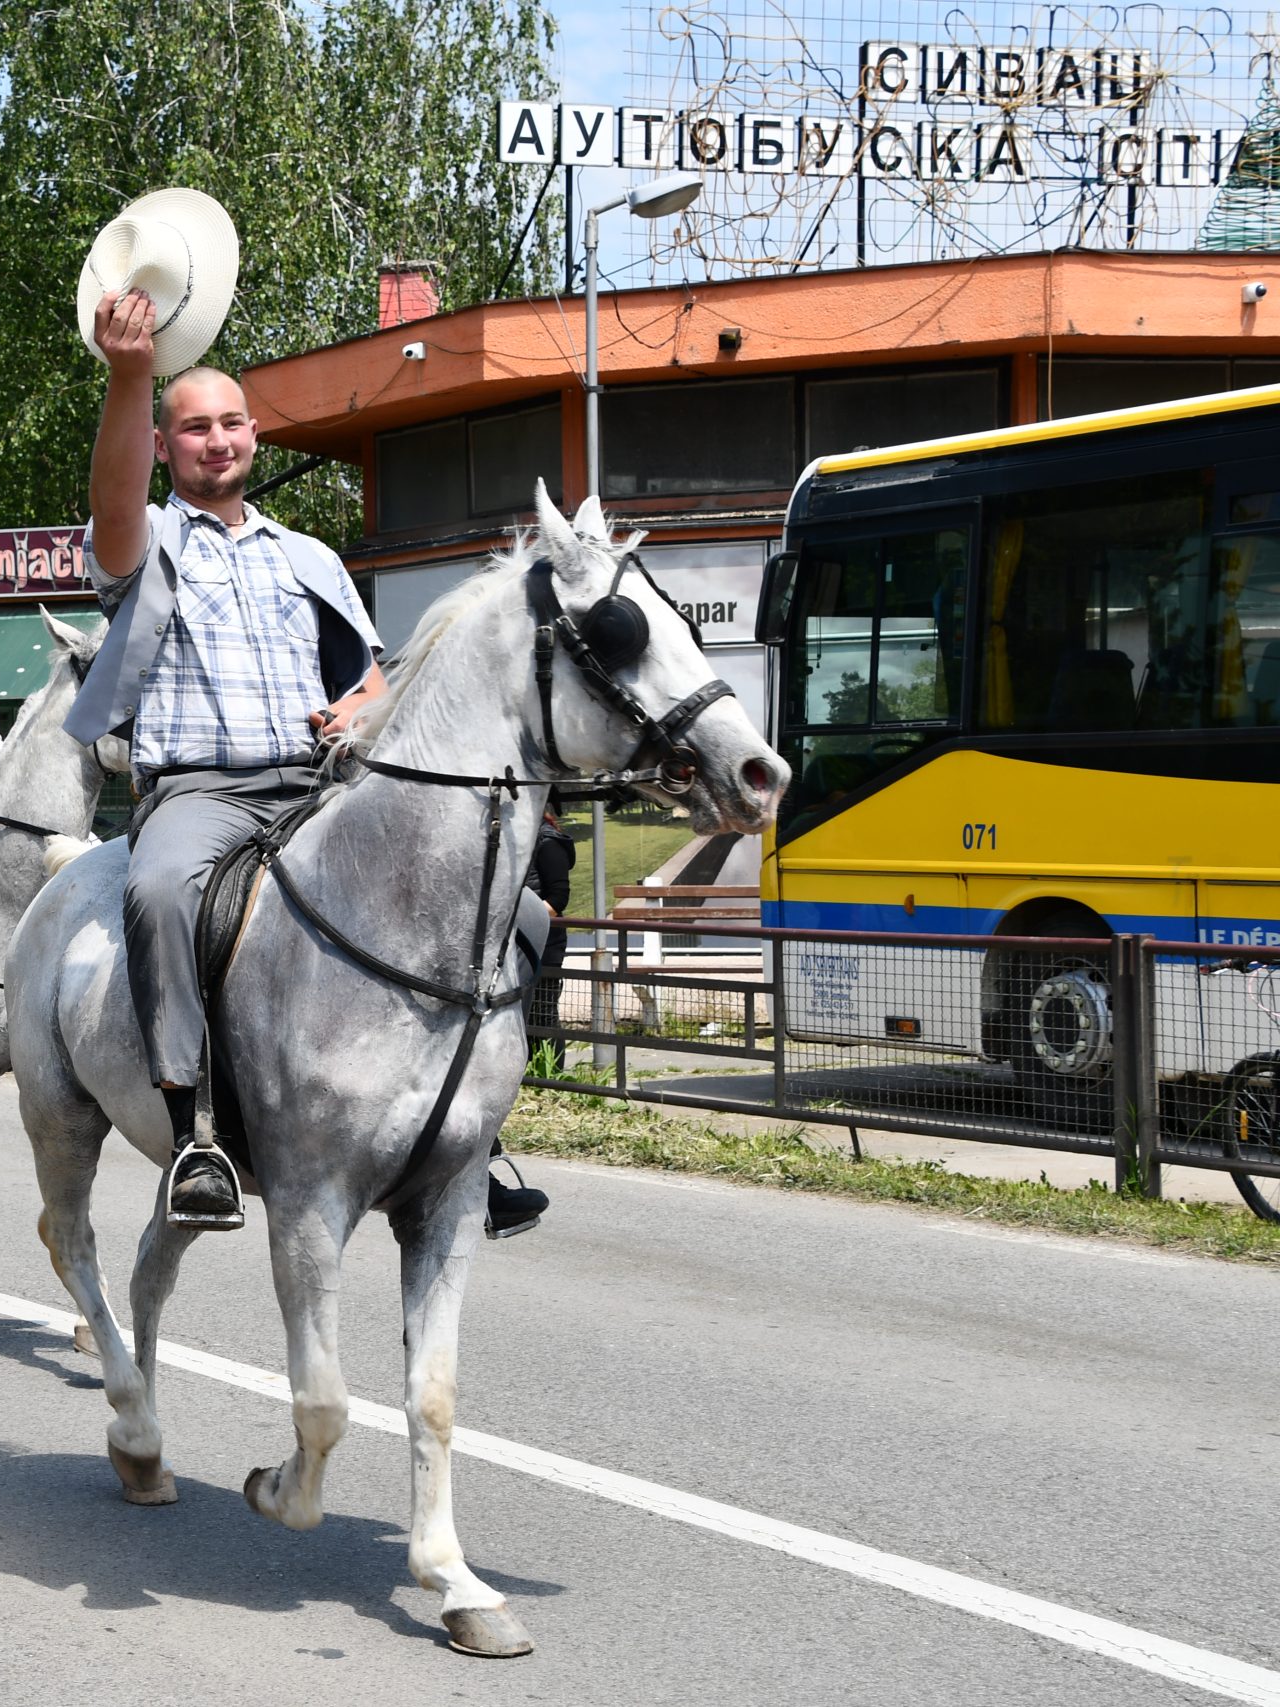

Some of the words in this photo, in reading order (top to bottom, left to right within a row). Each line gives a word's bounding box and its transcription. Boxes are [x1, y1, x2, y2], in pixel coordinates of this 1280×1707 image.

[507, 108, 1025, 176] АУТОБУСКА
[673, 600, 738, 628] apar
[962, 823, 997, 850] 071
